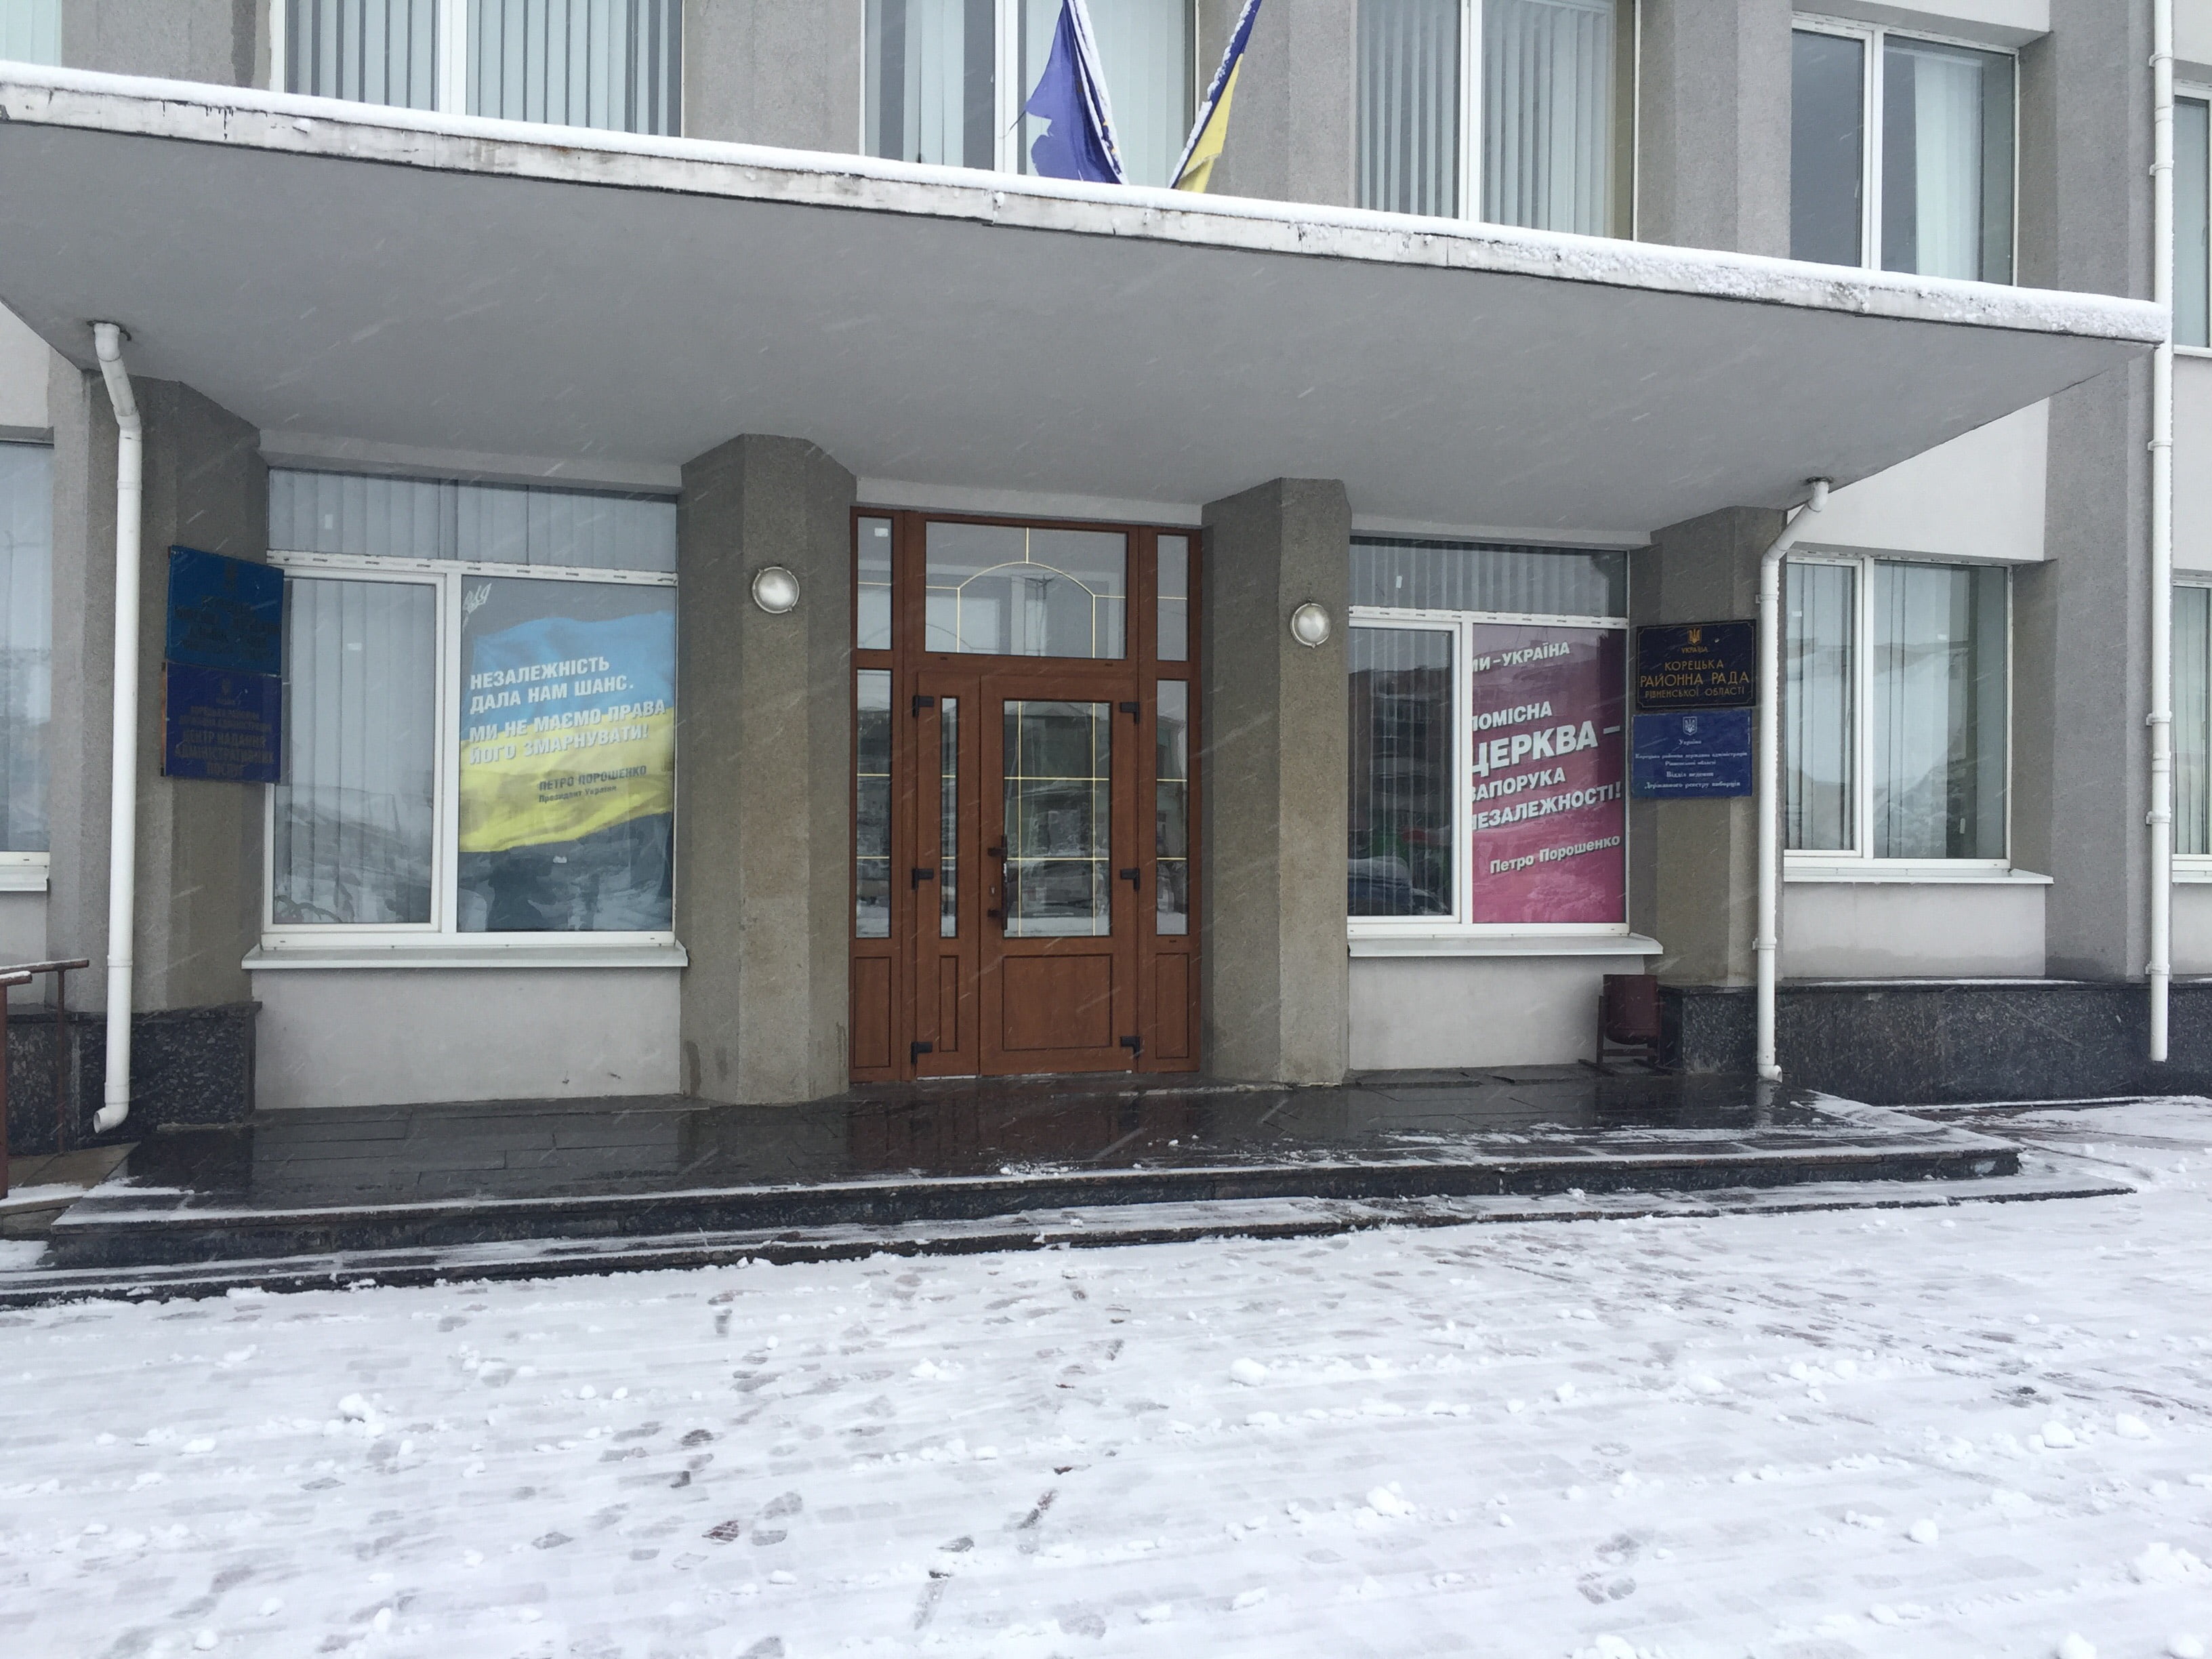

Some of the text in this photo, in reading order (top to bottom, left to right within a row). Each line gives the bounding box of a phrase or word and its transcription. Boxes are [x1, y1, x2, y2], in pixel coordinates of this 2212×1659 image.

[470, 656, 610, 690] НЕЗАЛЕЖНІСТЬ
[1640, 670, 1750, 688] РАЙОННА РАДА
[1664, 659, 1724, 672] КОРЕЦЬКА
[470, 674, 634, 715] ДАЛА НАМ ШАНС.
[1645, 685, 1744, 699] РІВНЕНСЬКОЇ ОБЛАСТІ
[469, 699, 667, 744] МИ НЕ МАЄМО ПРАВА
[469, 724, 649, 765] ЙОГО ЗМАРНУВАТИ!
[539, 765, 647, 792] ПЕТРО ПОРОШЕНКО
[1490, 836, 1620, 874] Петро Порошенко
